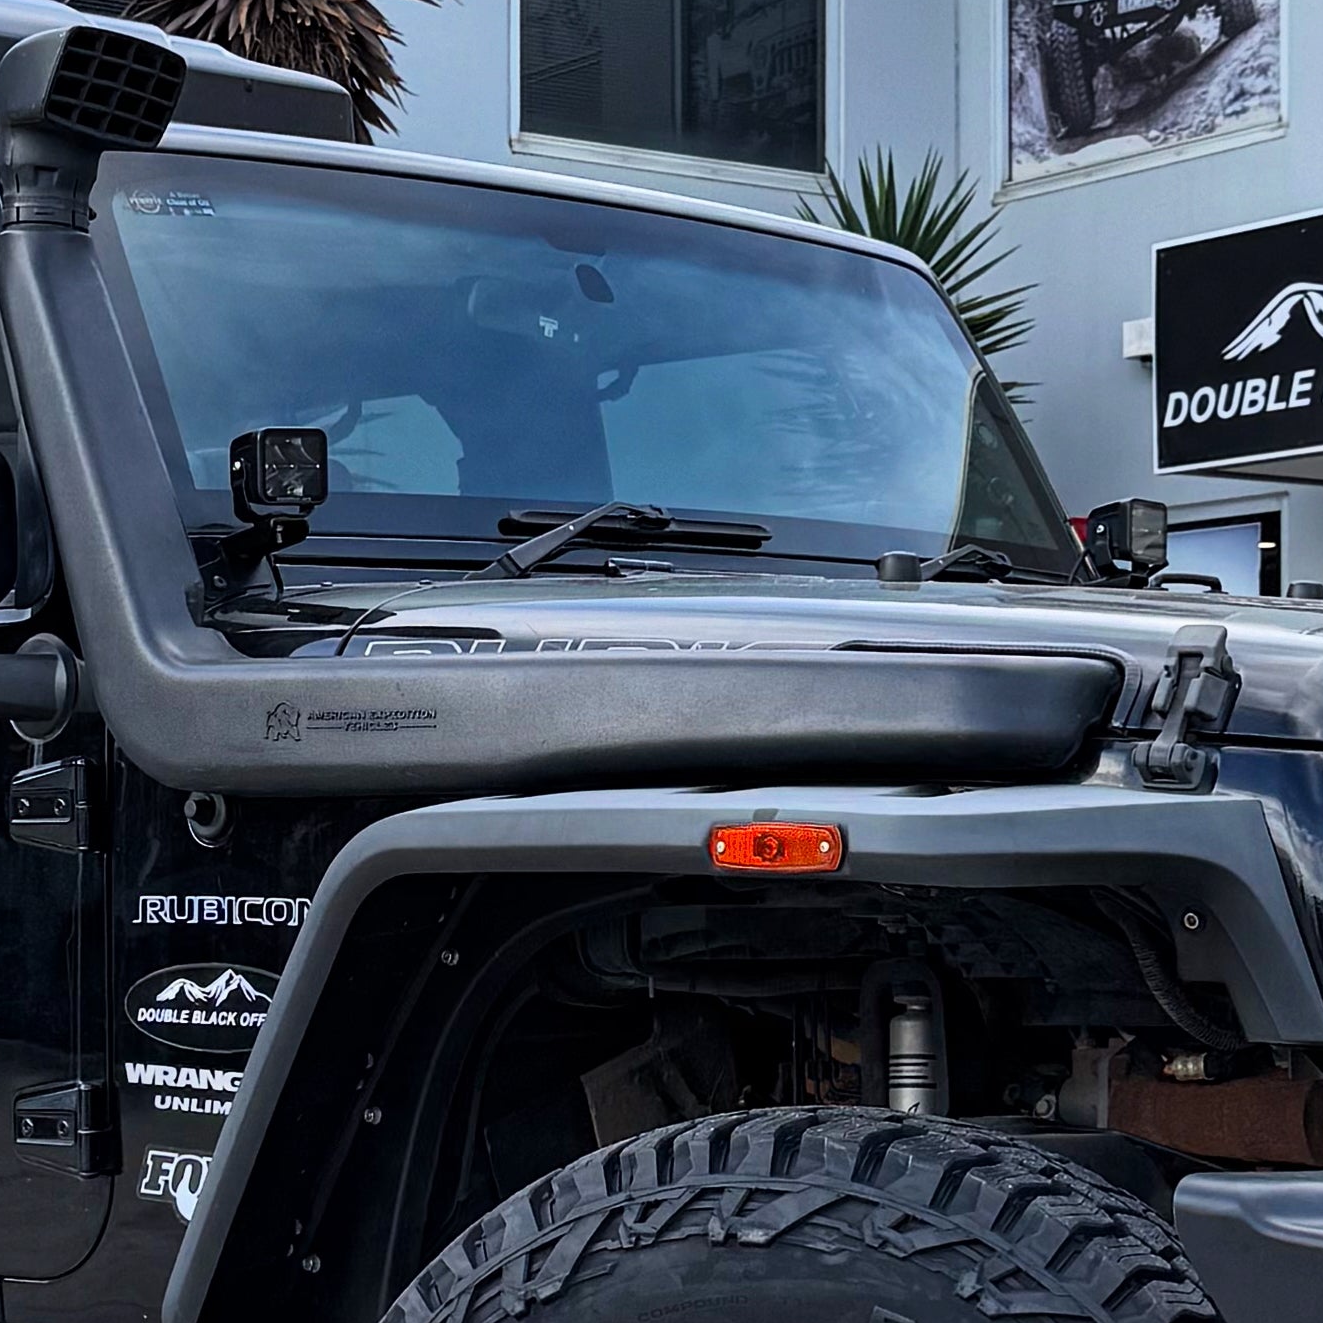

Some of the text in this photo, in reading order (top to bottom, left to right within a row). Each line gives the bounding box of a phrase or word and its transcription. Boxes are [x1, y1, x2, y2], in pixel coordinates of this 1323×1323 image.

[1162, 366, 1315, 429] DOUBLE
[307, 708, 438, 721] AMERICAN EXPEDITION
[137, 1007, 190, 1024] DOUBLE
[191, 1009, 237, 1026] BLACK
